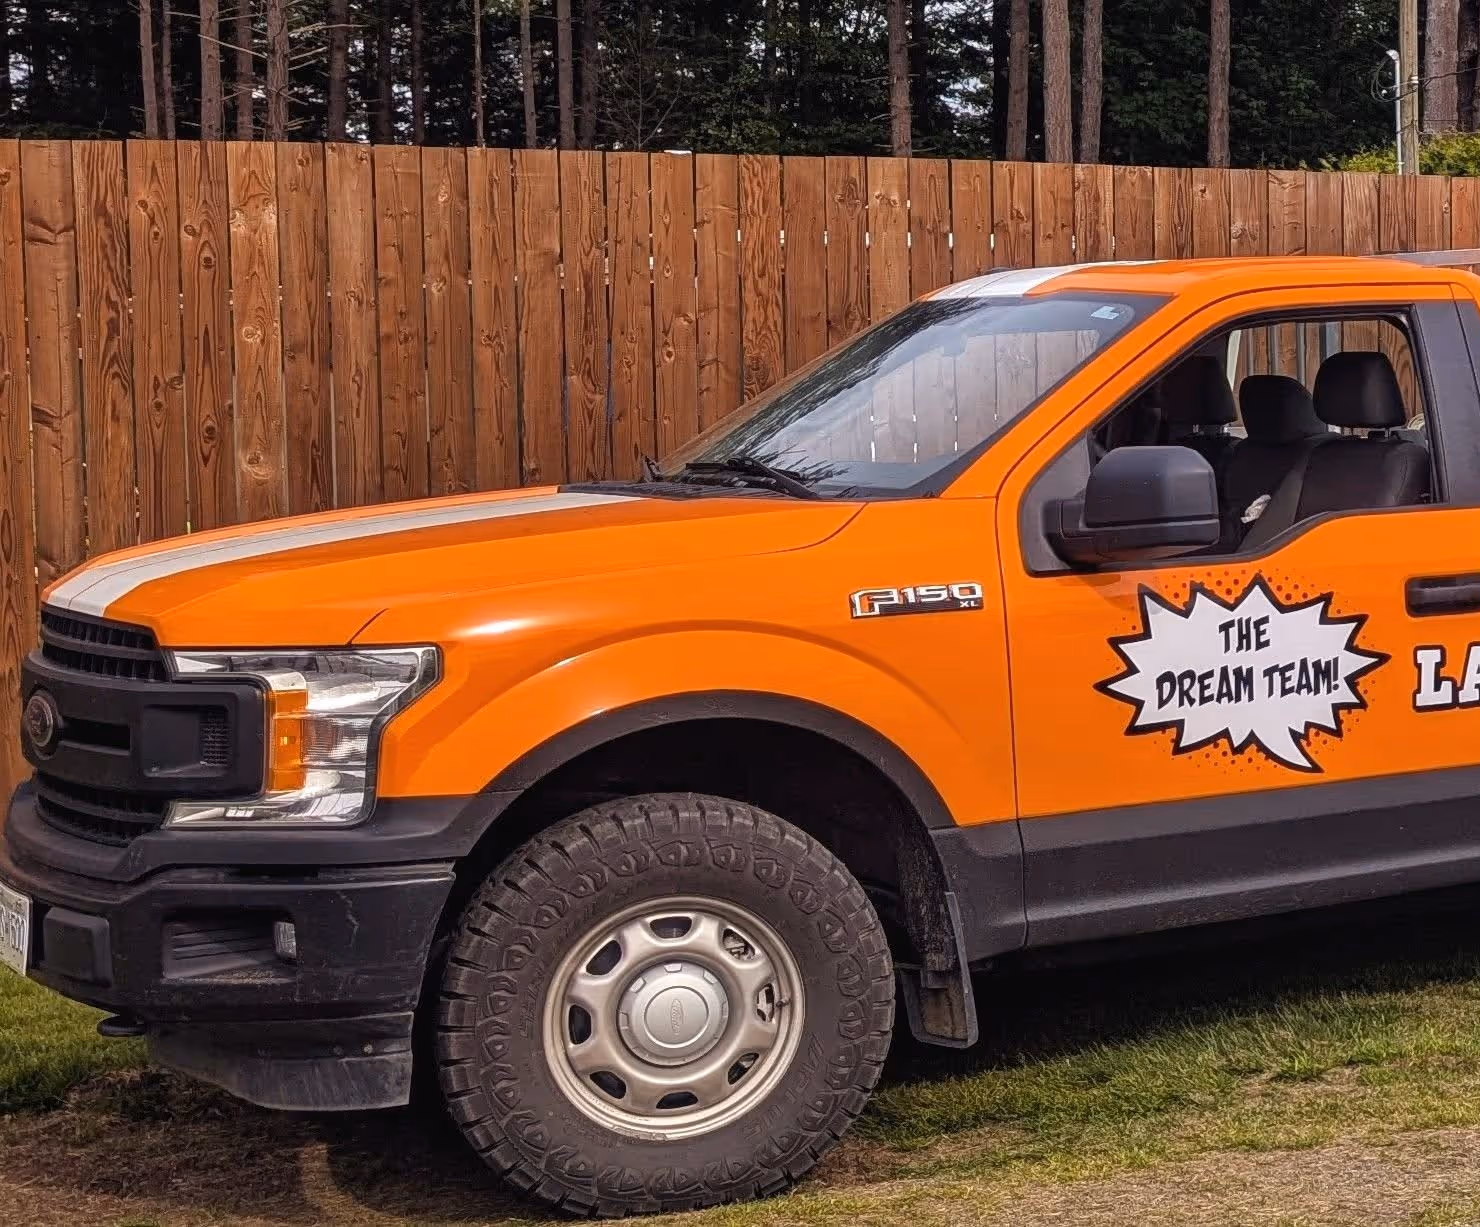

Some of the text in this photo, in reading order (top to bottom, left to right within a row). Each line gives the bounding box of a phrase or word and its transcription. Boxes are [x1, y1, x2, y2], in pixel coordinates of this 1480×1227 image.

[959, 599, 980, 608] XL
[1218, 614, 1271, 654] THE
[1155, 655, 1340, 711] DREAM TEAM!
